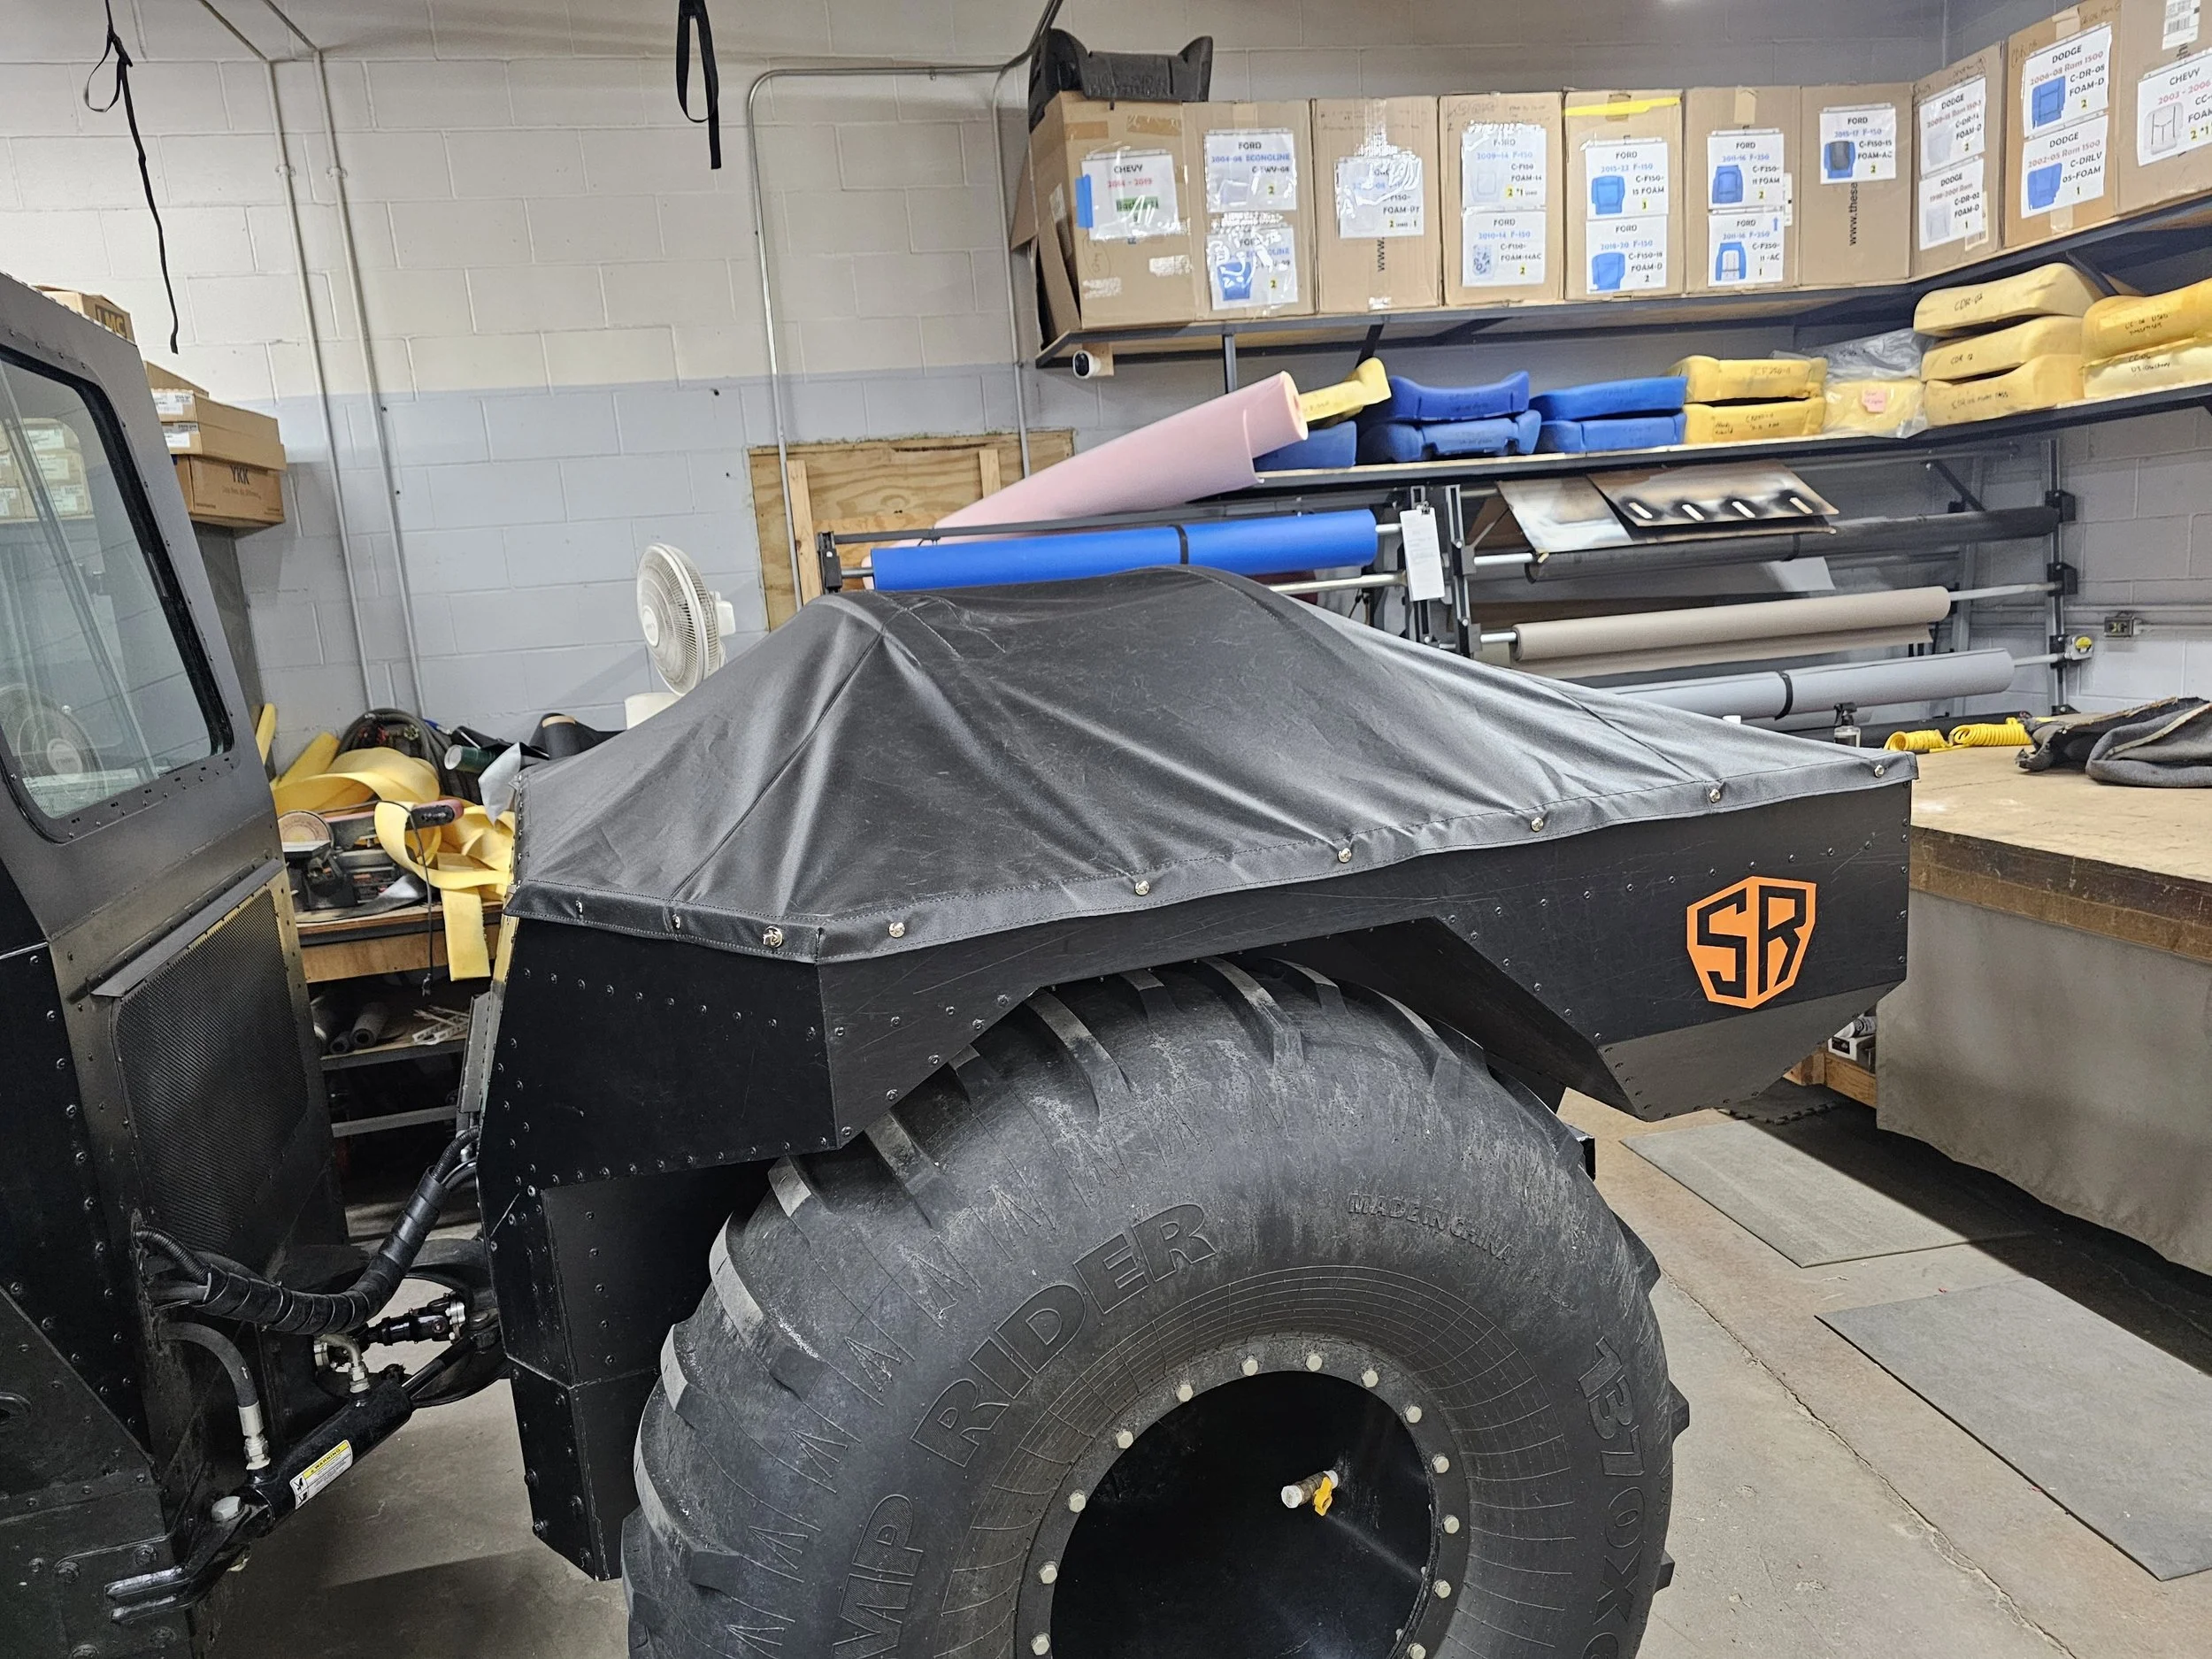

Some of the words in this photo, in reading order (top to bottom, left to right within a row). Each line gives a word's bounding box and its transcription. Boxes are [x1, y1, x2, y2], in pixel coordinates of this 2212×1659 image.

[2052, 44, 2082, 64] DODGE
[2064, 58, 2083, 73] Ram
[2085, 50, 2104, 65] 1500
[2170, 67, 2200, 86] CHEVY
[2069, 77, 2105, 96] FOAM-D
[2188, 81, 2211, 94] 2006
[1941, 93, 1964, 110] DODGE
[2081, 99, 2087, 108] 2
[1952, 107, 1965, 119] Ram
[1955, 123, 1982, 140] FOAM-D
[2190, 130, 2197, 139] 2
[2049, 132, 2079, 148] DODGE
[2062, 147, 2080, 157] Ram
[2082, 140, 2101, 150] 1500
[1246, 153, 1290, 162] ECONOLINE
[2070, 151, 2102, 167] C-DRLV
[1113, 164, 1143, 173] CHEVY
[1632, 162, 1654, 171] F-150
[1870, 165, 1876, 173] 2
[1940, 173, 1962, 187] DODGE
[2062, 165, 2101, 183] 05-FOAM
[1268, 186, 1274, 195] 2
[1959, 182, 1973, 193] Ram
[2077, 186, 2080, 195] 1
[1954, 192, 1979, 205] C-DR-02
[1954, 204, 1979, 218] FOAM-D
[1736, 219, 1756, 227] FORD
[1520, 266, 1525, 275] 2
[1631, 263, 1663, 273] FOAM-D
[1271, 280, 1276, 288] 2
[229, 465, 250, 485] YKK
[1697, 885, 1807, 999] SR
[1348, 1193, 1419, 1223] MADE
[1422, 1204, 1447, 1231] IN
[1449, 1217, 1516, 1264] CHINA
[910, 1203, 1217, 1467] RIDER
[314, 1448, 341, 1469] WARNING
